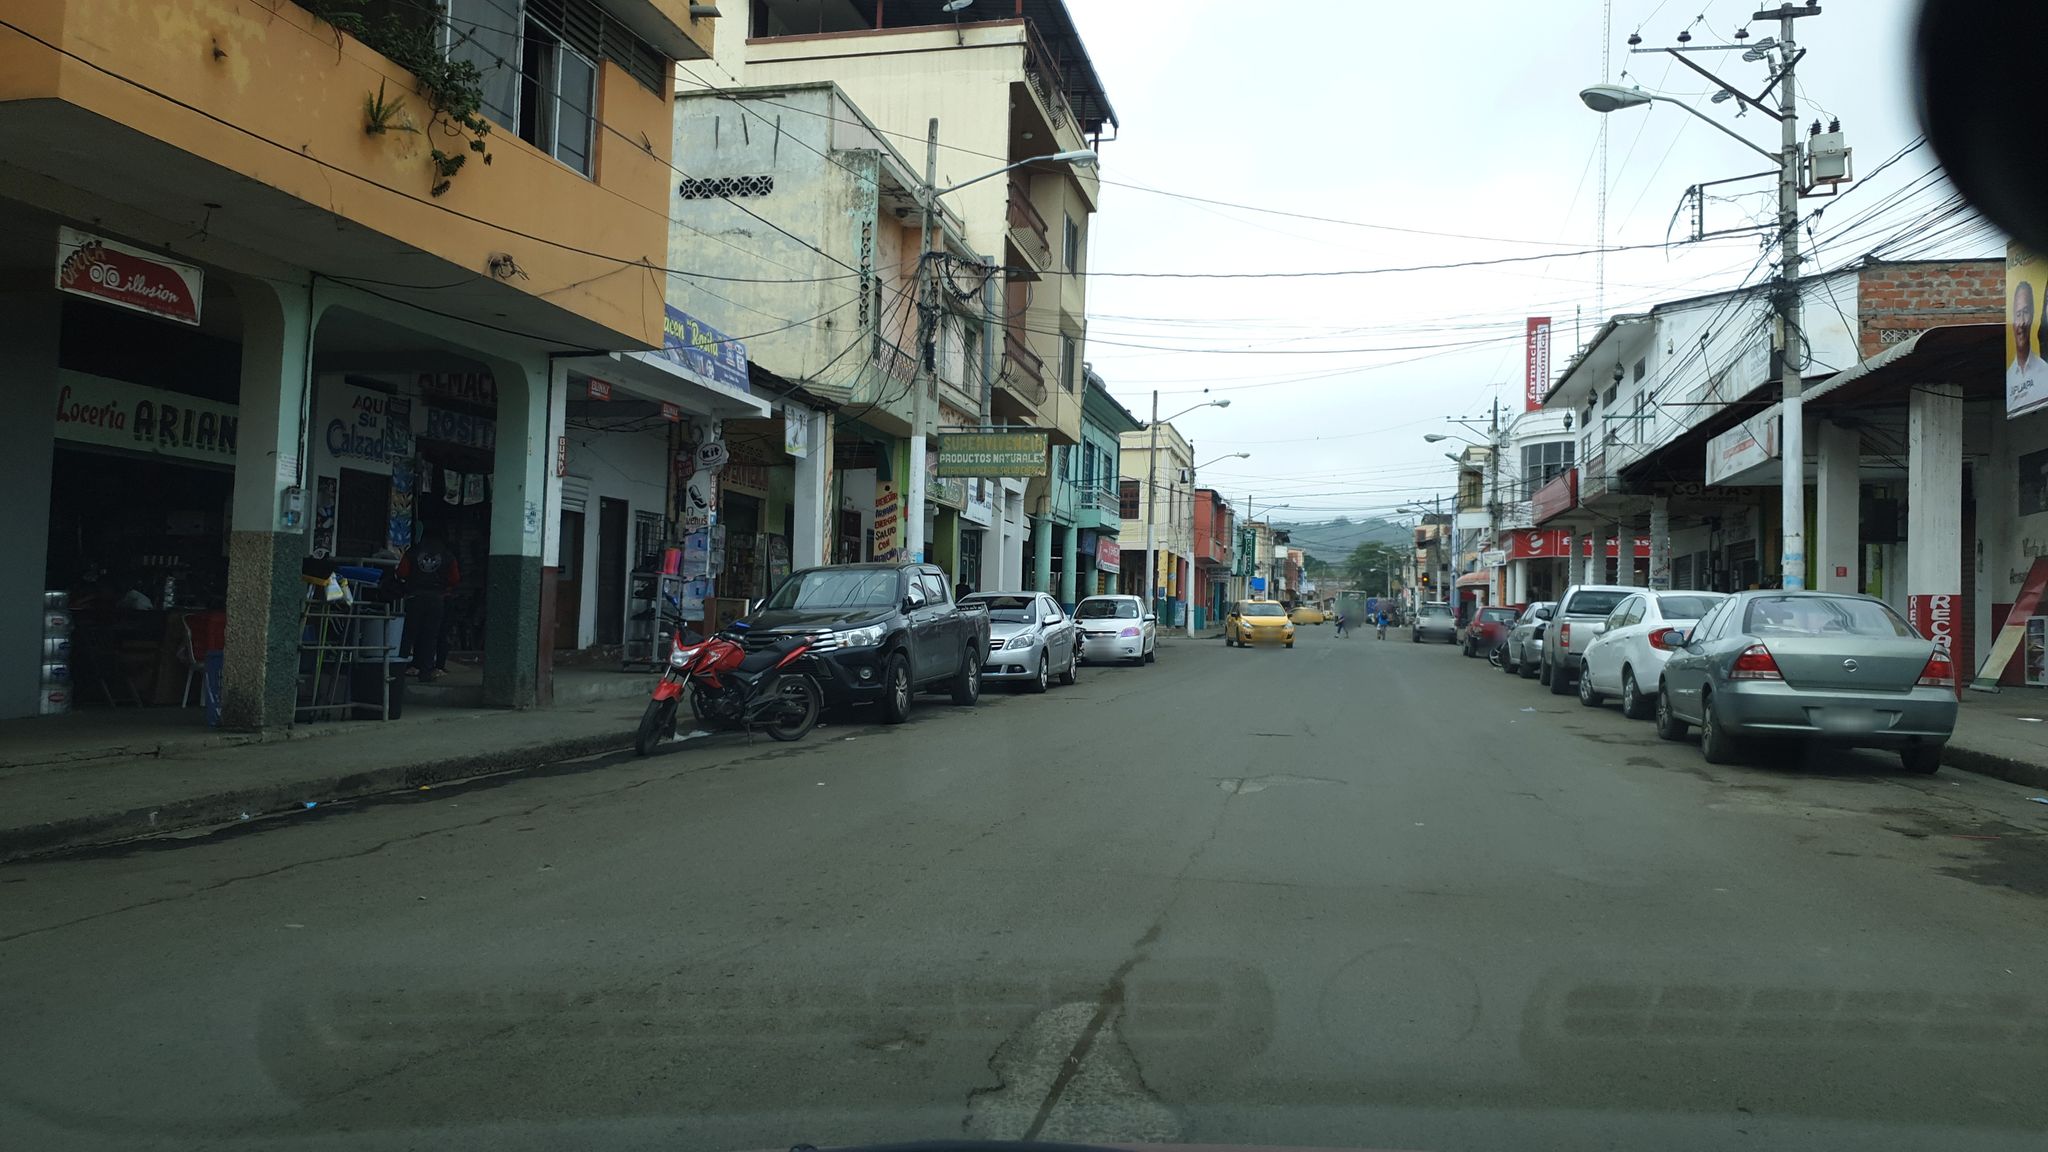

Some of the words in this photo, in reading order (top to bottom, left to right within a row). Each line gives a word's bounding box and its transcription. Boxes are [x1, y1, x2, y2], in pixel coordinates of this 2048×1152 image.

[126, 274, 180, 303] illusion
[1528, 330, 1537, 400] farmacias
[359, 412, 377, 428] Su
[943, 434, 1044, 450] SUPERVIVENCIA
[940, 454, 991, 463] PRODUCTOS
[993, 453, 1046, 463] NATURALES
[875, 526, 896, 540] SALUD
